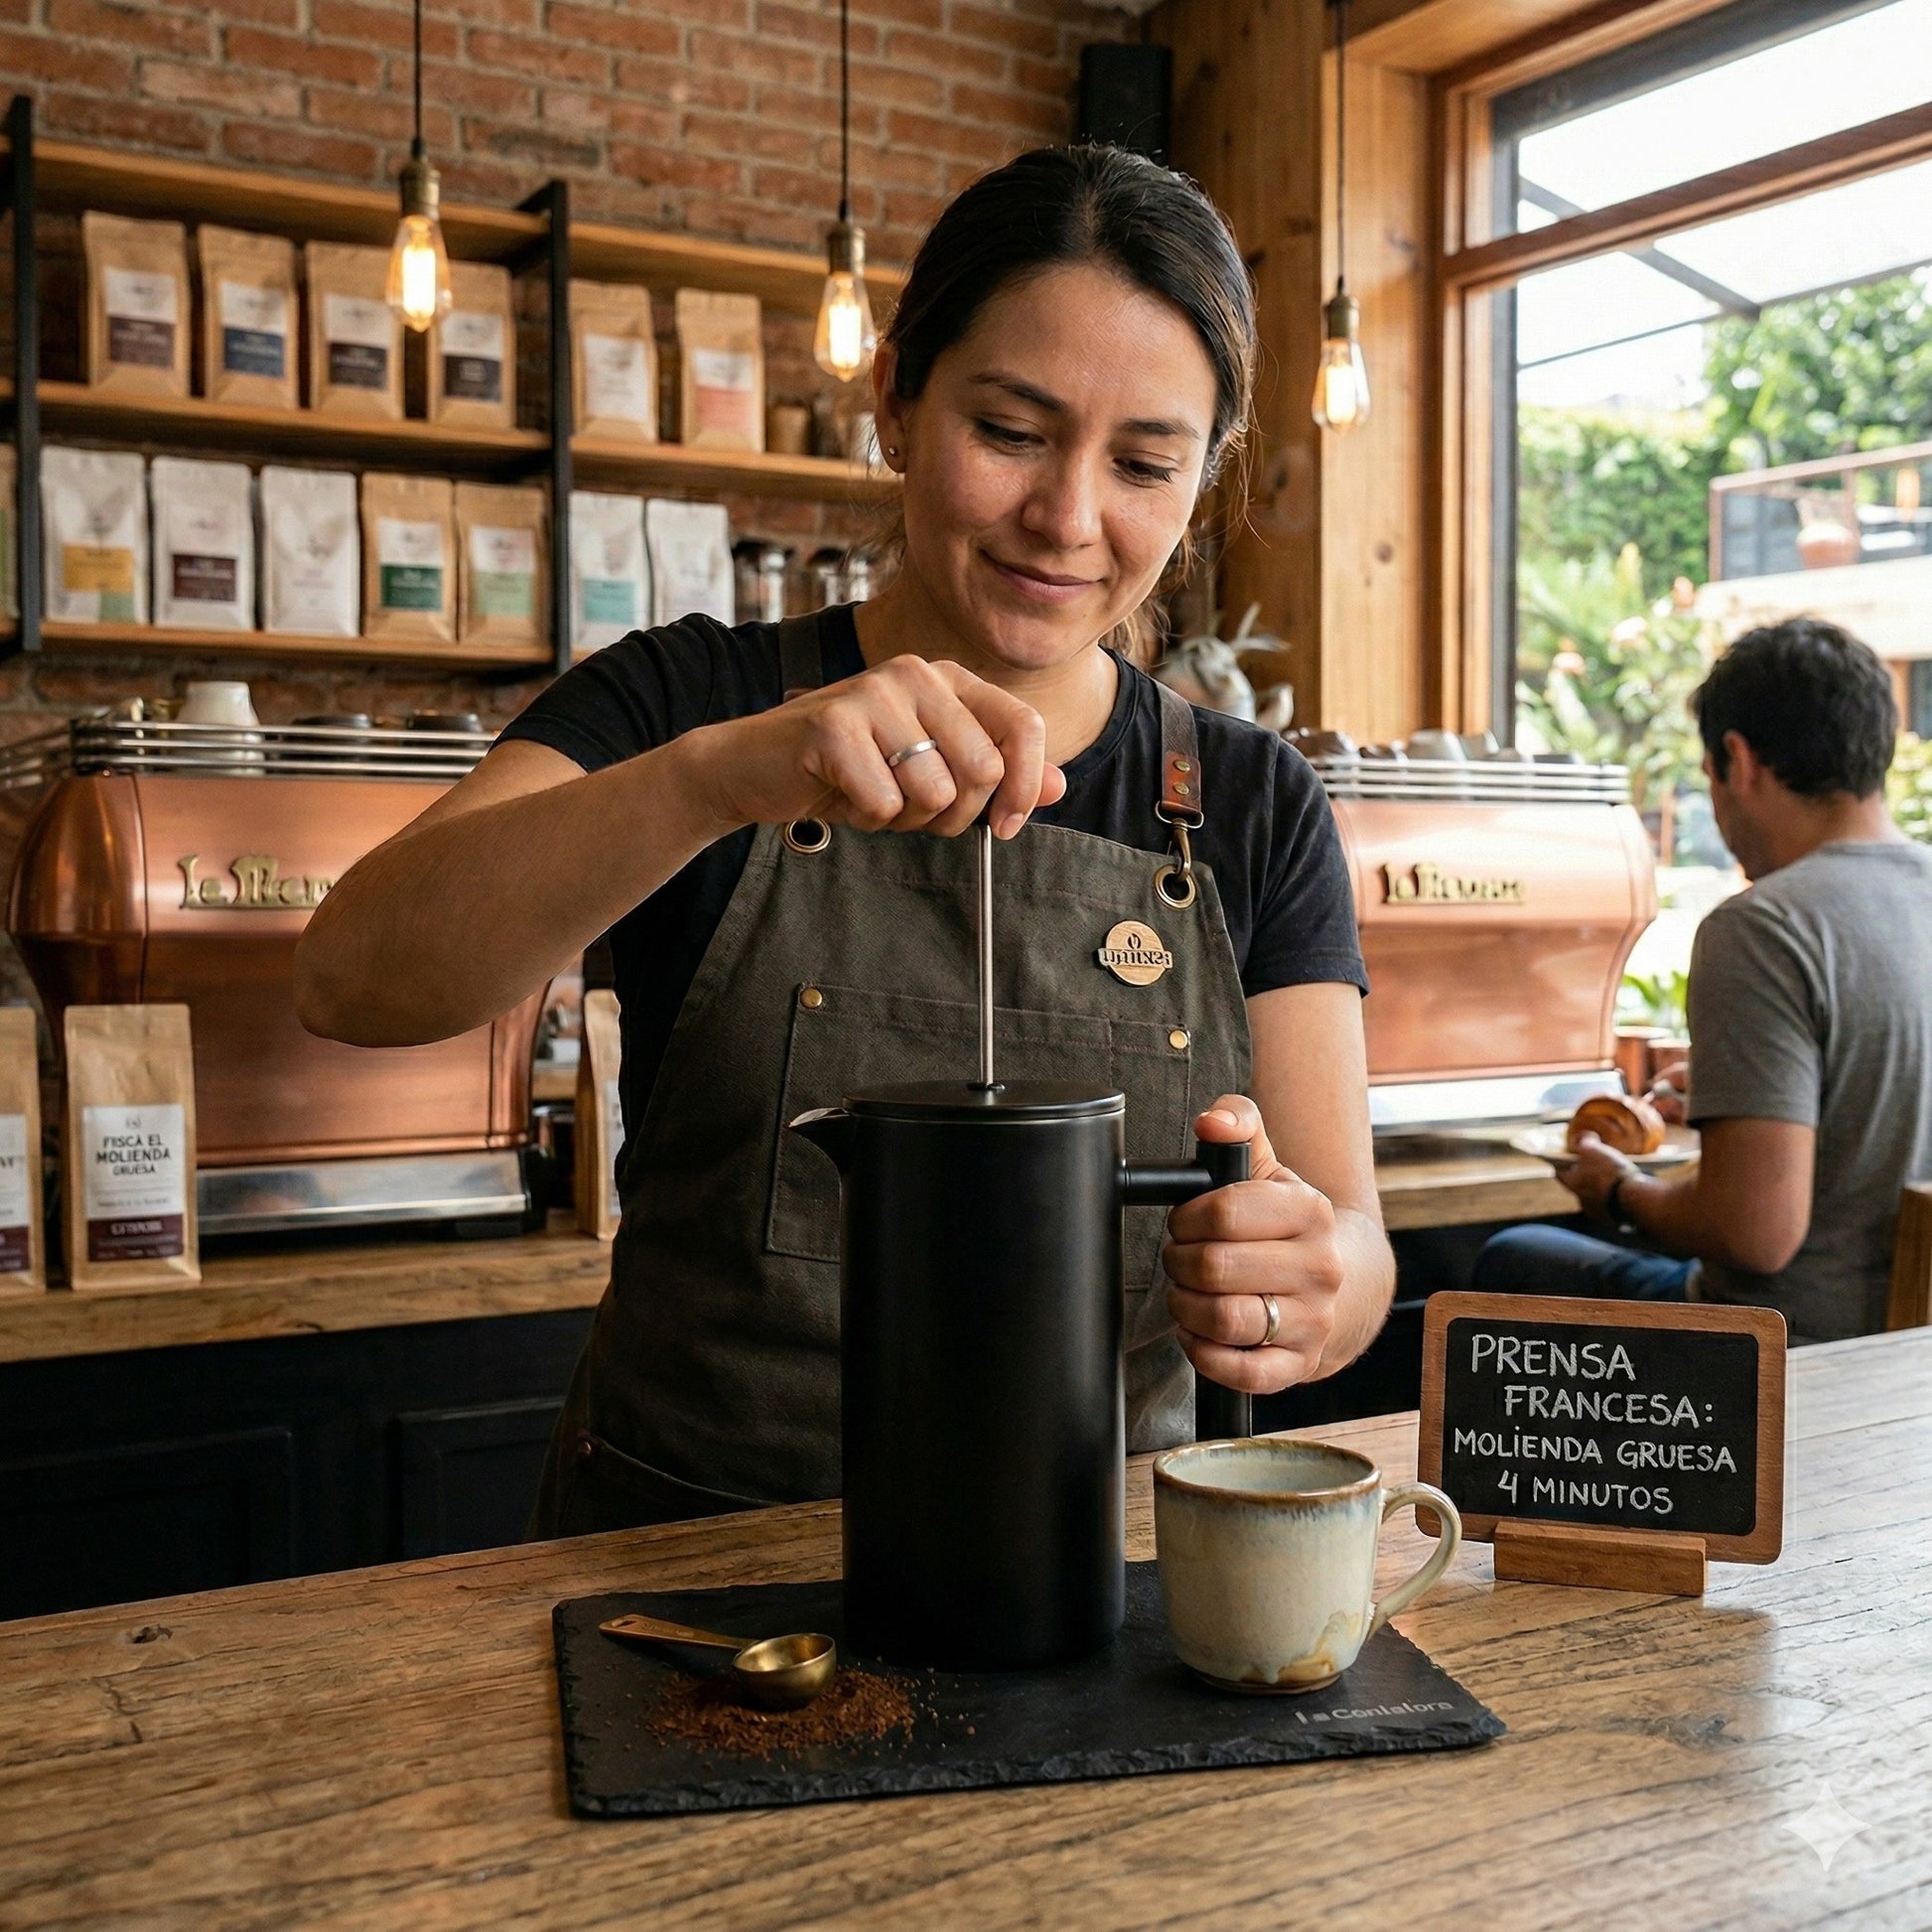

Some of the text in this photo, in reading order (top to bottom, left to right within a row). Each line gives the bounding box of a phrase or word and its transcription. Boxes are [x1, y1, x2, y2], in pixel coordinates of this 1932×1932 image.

[96, 1148, 171, 1164] MOLIENDA
[1471, 1333, 1636, 1381] PRENSA
[1504, 1385, 1714, 1429] FRANCESA:
[1616, 1440, 1737, 1473] GRUESA
[1497, 1470, 1674, 1514] 4 MINUTOS
